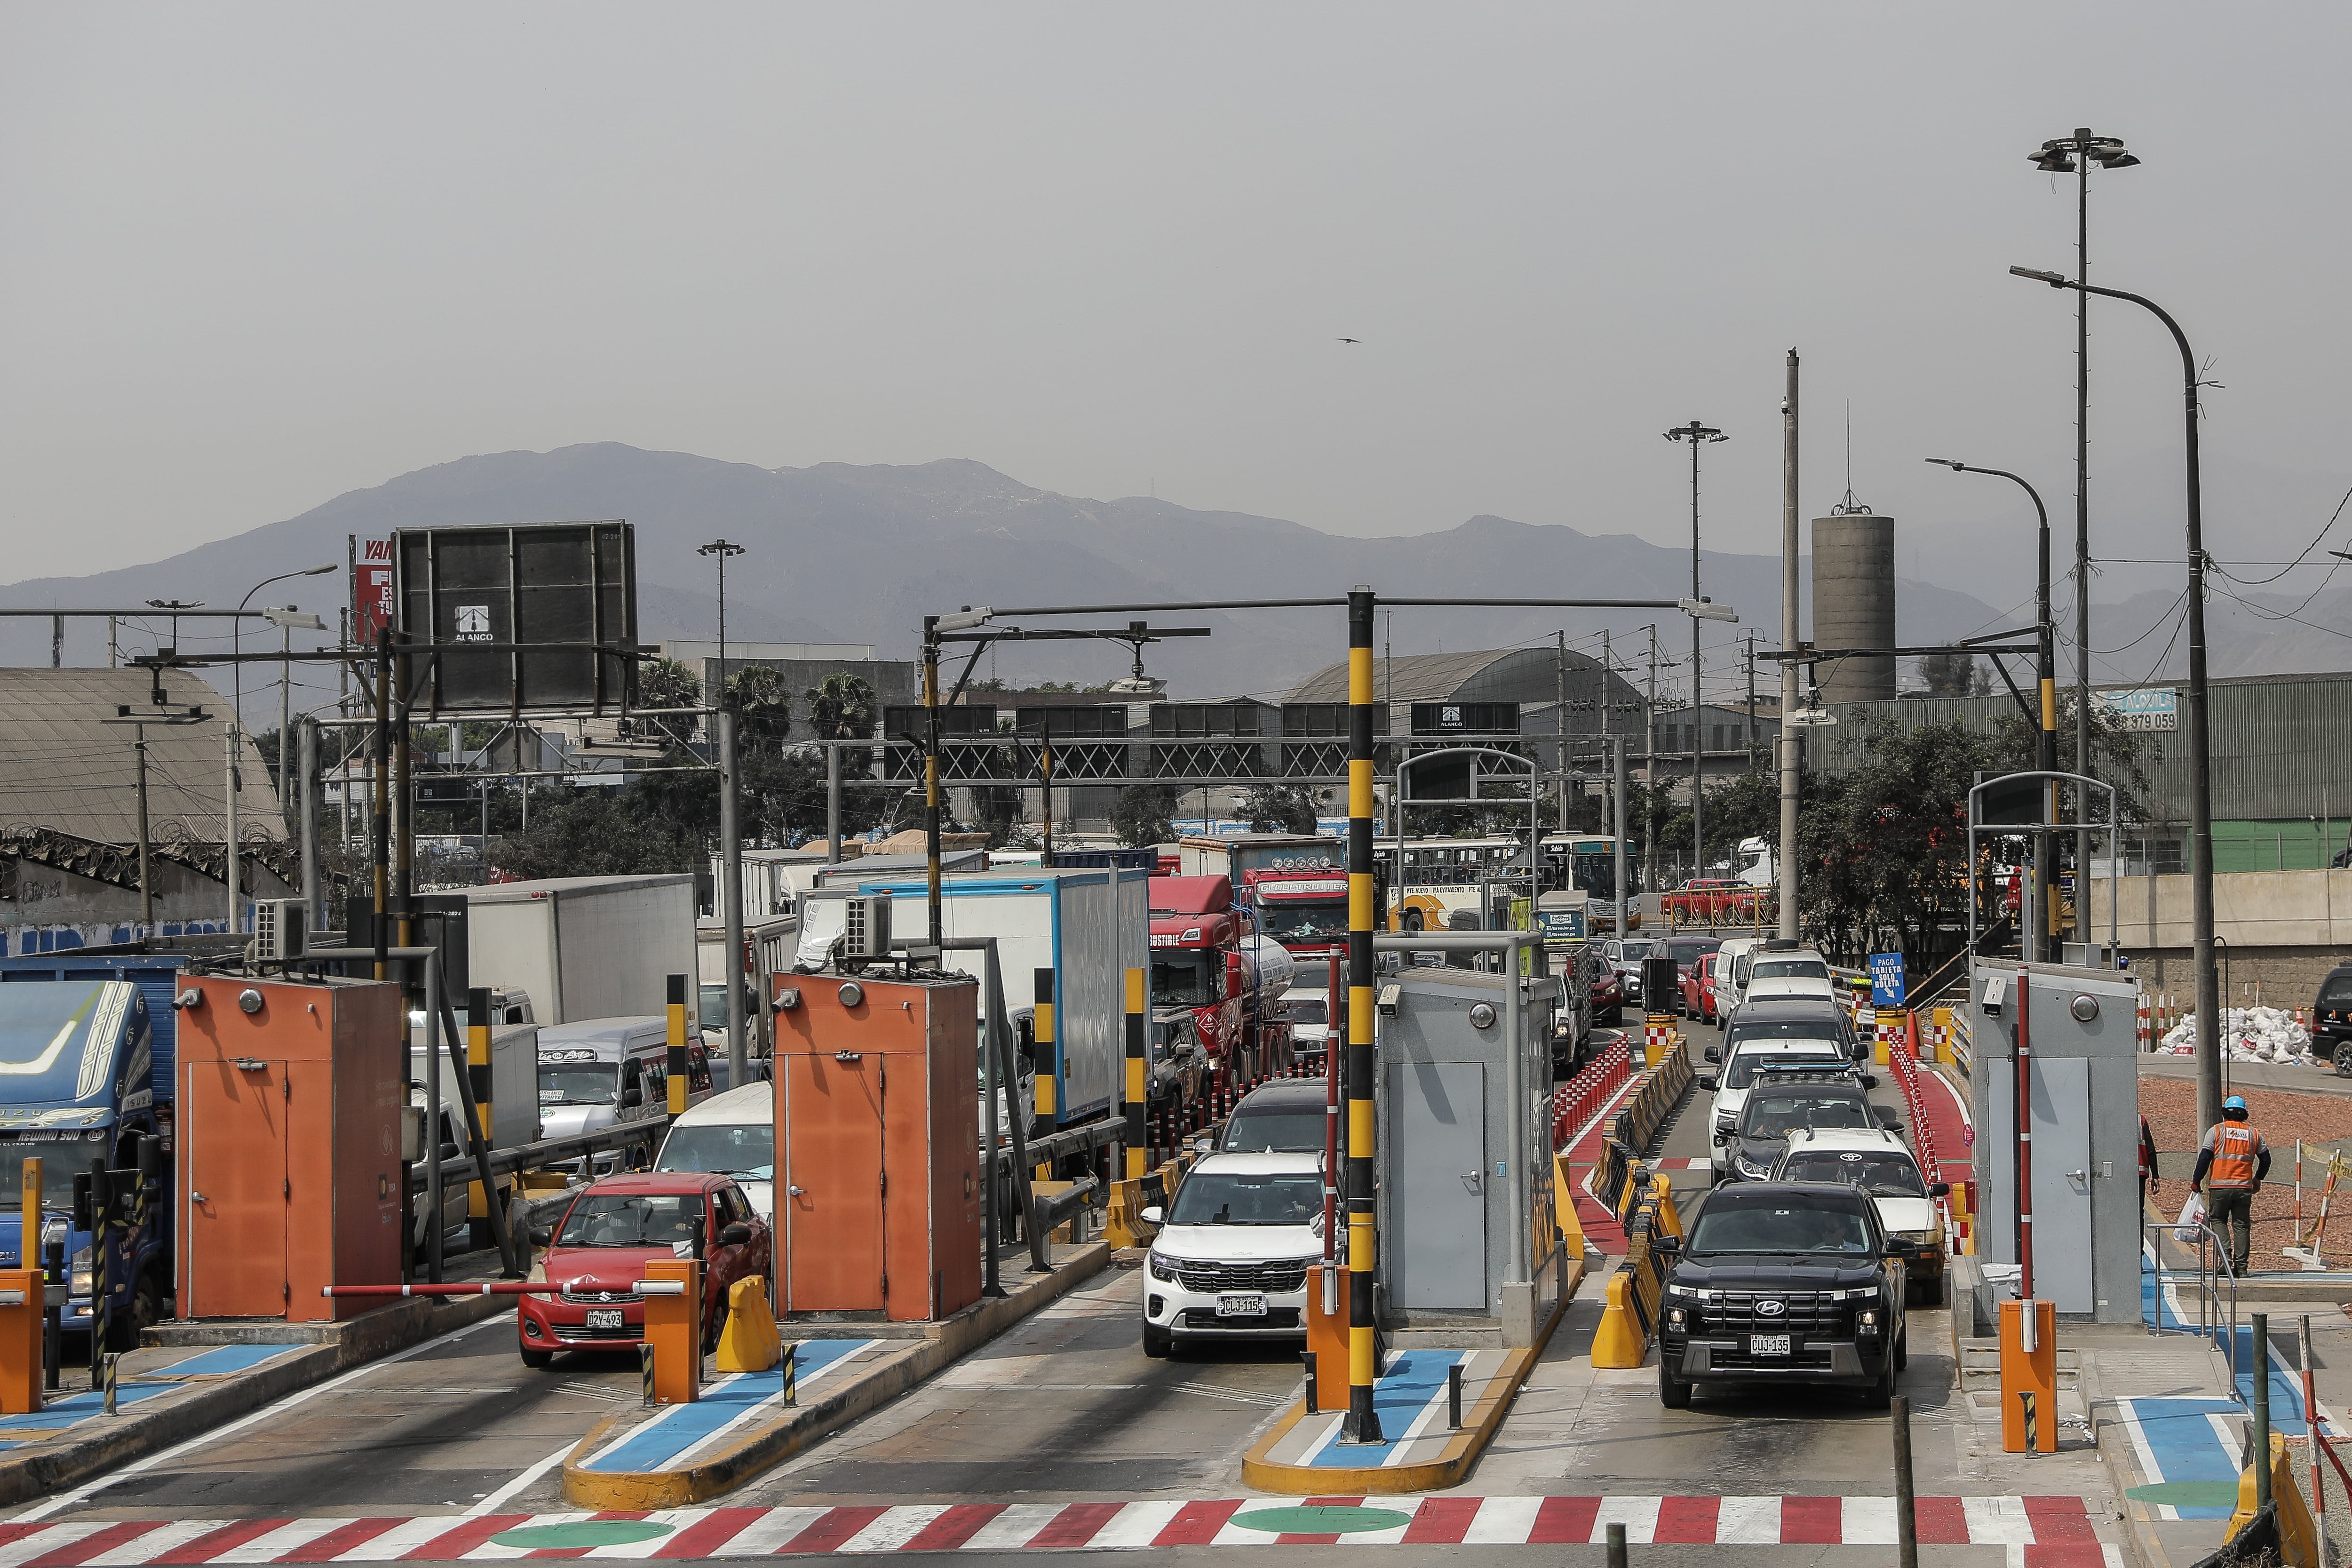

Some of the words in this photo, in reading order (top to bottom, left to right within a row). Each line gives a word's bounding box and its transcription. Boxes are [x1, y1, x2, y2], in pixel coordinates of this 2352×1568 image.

[2126, 693, 2172, 709] ALQUILA
[2154, 713, 2176, 729] 059
[1878, 958, 1894, 966] PAGO
[1871, 965, 1902, 975] TARJETA
[1875, 979, 1900, 988] BOLETA
[126, 1093, 152, 1108] ISUZU
[59, 1130, 82, 1141] 500
[1225, 1301, 1258, 1311] CLJ-115
[588, 1314, 621, 1325] D2Y-493
[1752, 1339, 1788, 1351] CUJ-135
